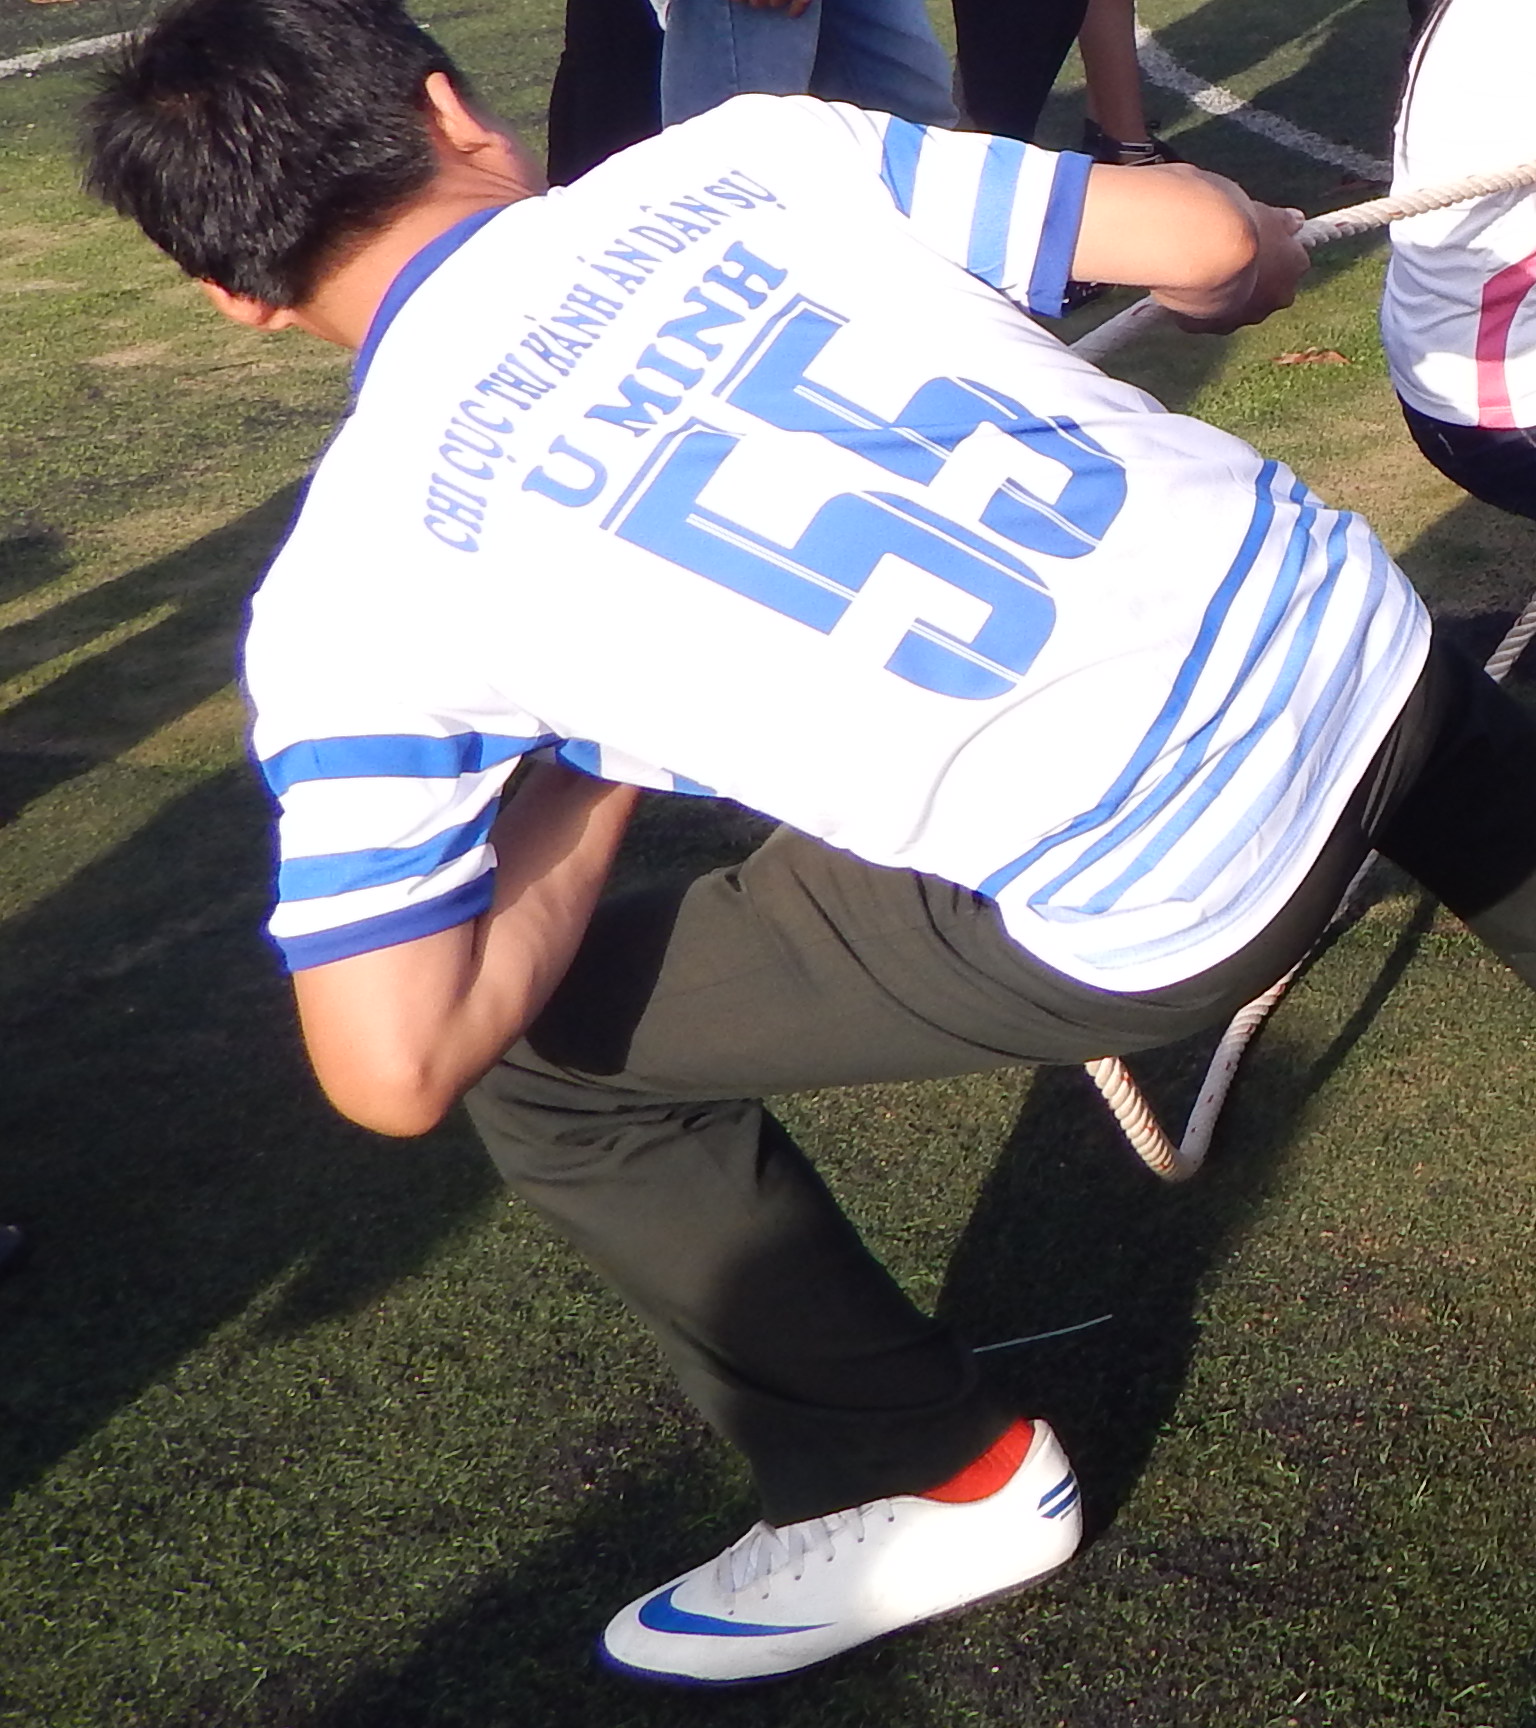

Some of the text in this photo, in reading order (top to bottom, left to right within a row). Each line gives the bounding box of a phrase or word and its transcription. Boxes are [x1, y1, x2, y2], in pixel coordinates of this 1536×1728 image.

[628, 194, 732, 254] DÂN
[474, 352, 558, 411] THI
[521, 240, 789, 508] U MINH
[438, 399, 517, 480] CỤC
[423, 472, 488, 553] CHI
[600, 293, 1128, 701] 55
